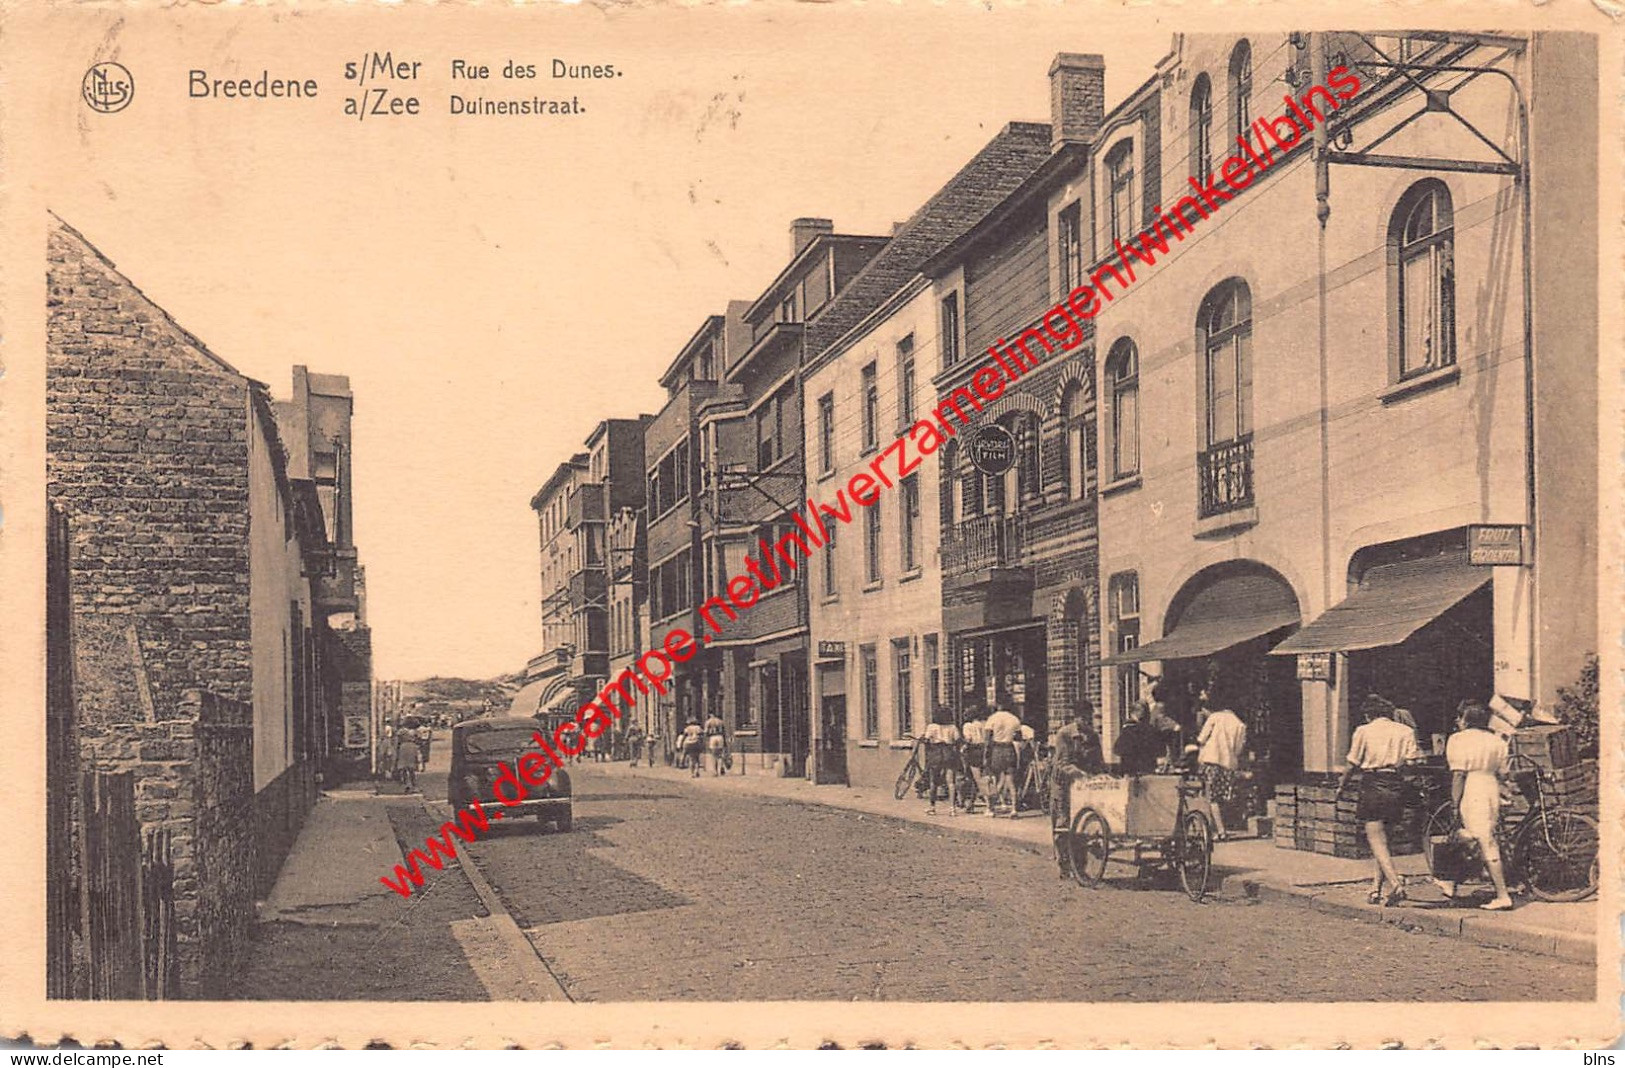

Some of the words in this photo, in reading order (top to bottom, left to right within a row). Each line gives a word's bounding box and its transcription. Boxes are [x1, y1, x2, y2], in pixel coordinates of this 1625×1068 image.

[344, 51, 422, 83] s/Mer
[452, 59, 490, 79] Rue
[502, 59, 536, 79] des
[552, 59, 623, 79] Dunes.
[189, 69, 318, 98] Breedene
[344, 85, 420, 120] a/Zee
[450, 95, 586, 115] Duinenstraat.
[1478, 527, 1514, 541] FRUIT
